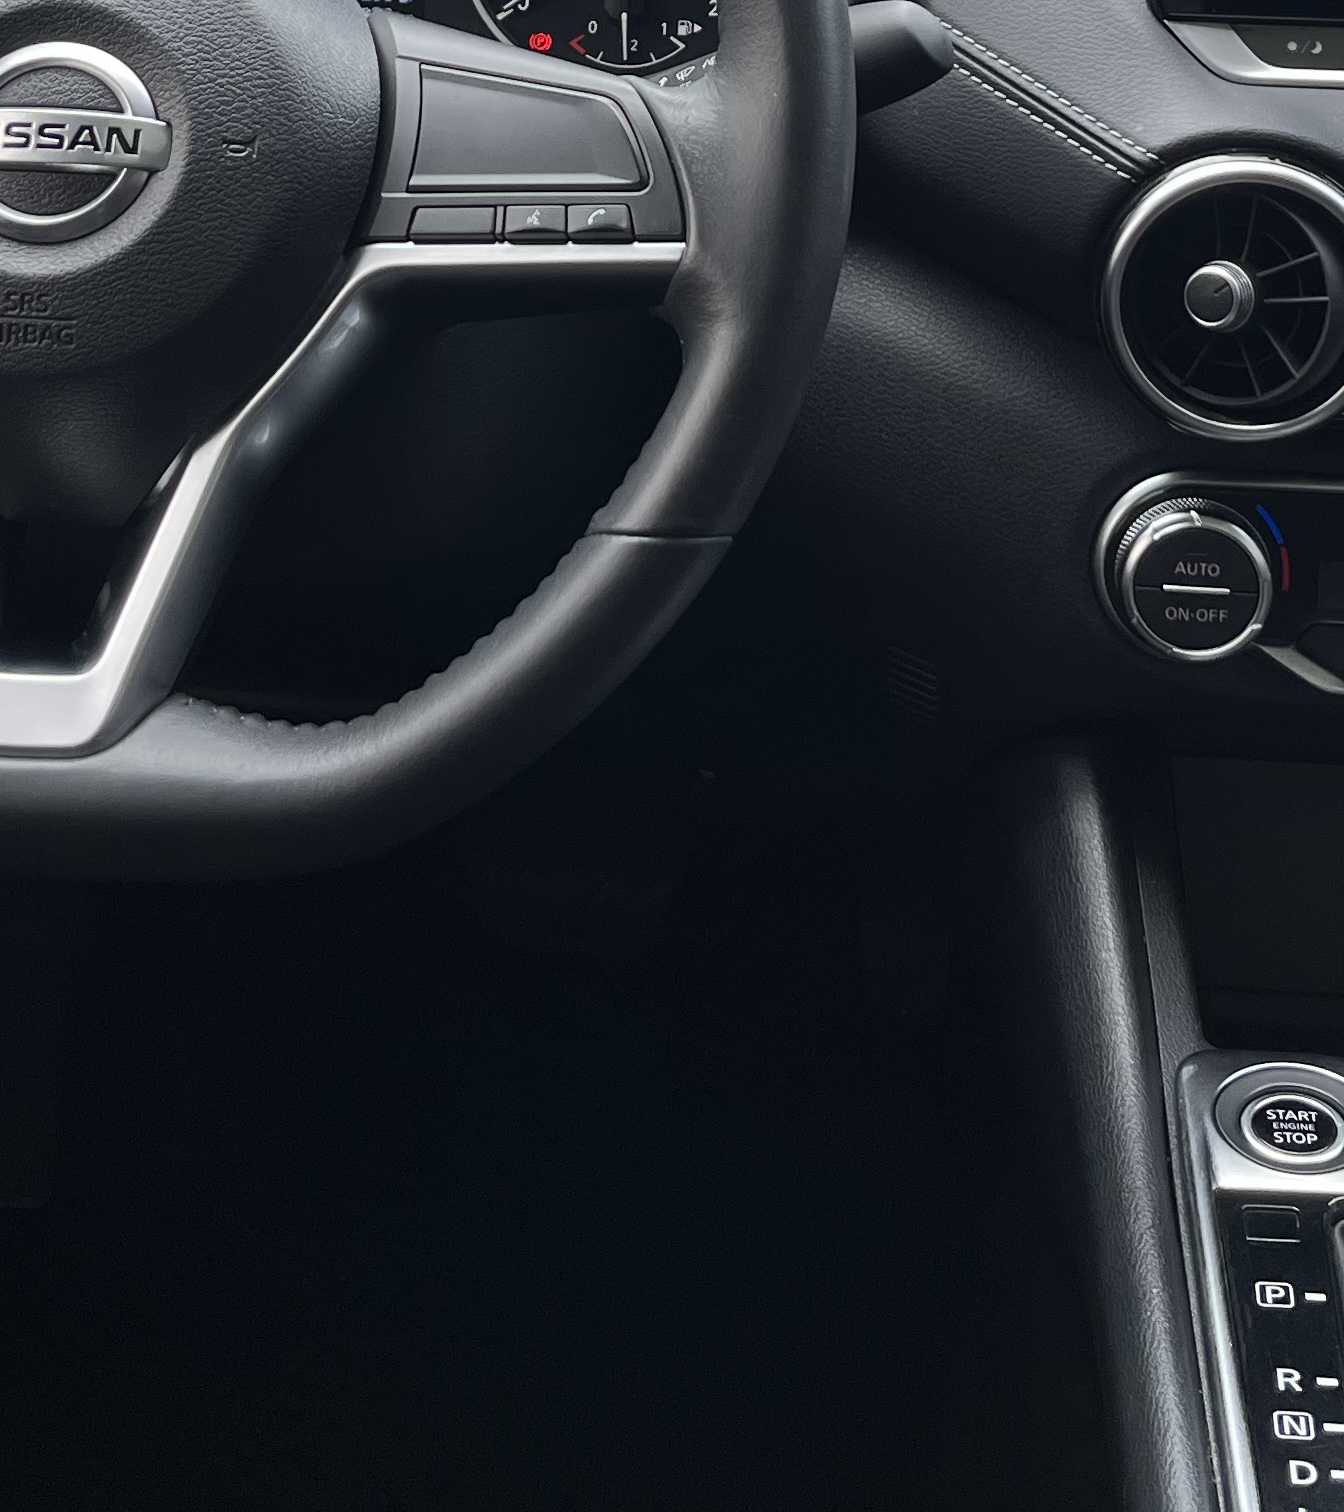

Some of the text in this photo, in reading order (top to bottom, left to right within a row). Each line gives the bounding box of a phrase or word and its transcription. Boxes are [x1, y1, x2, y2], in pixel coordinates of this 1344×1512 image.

[4, 292, 52, 313] SRS
[1174, 561, 1221, 578] AUTO
[1266, 1109, 1318, 1122] START
[1272, 1122, 1316, 1131] ENGINE
[1273, 1131, 1318, 1145] STOP
[1276, 1368, 1303, 1393] R
[1289, 1459, 1318, 1485] D
